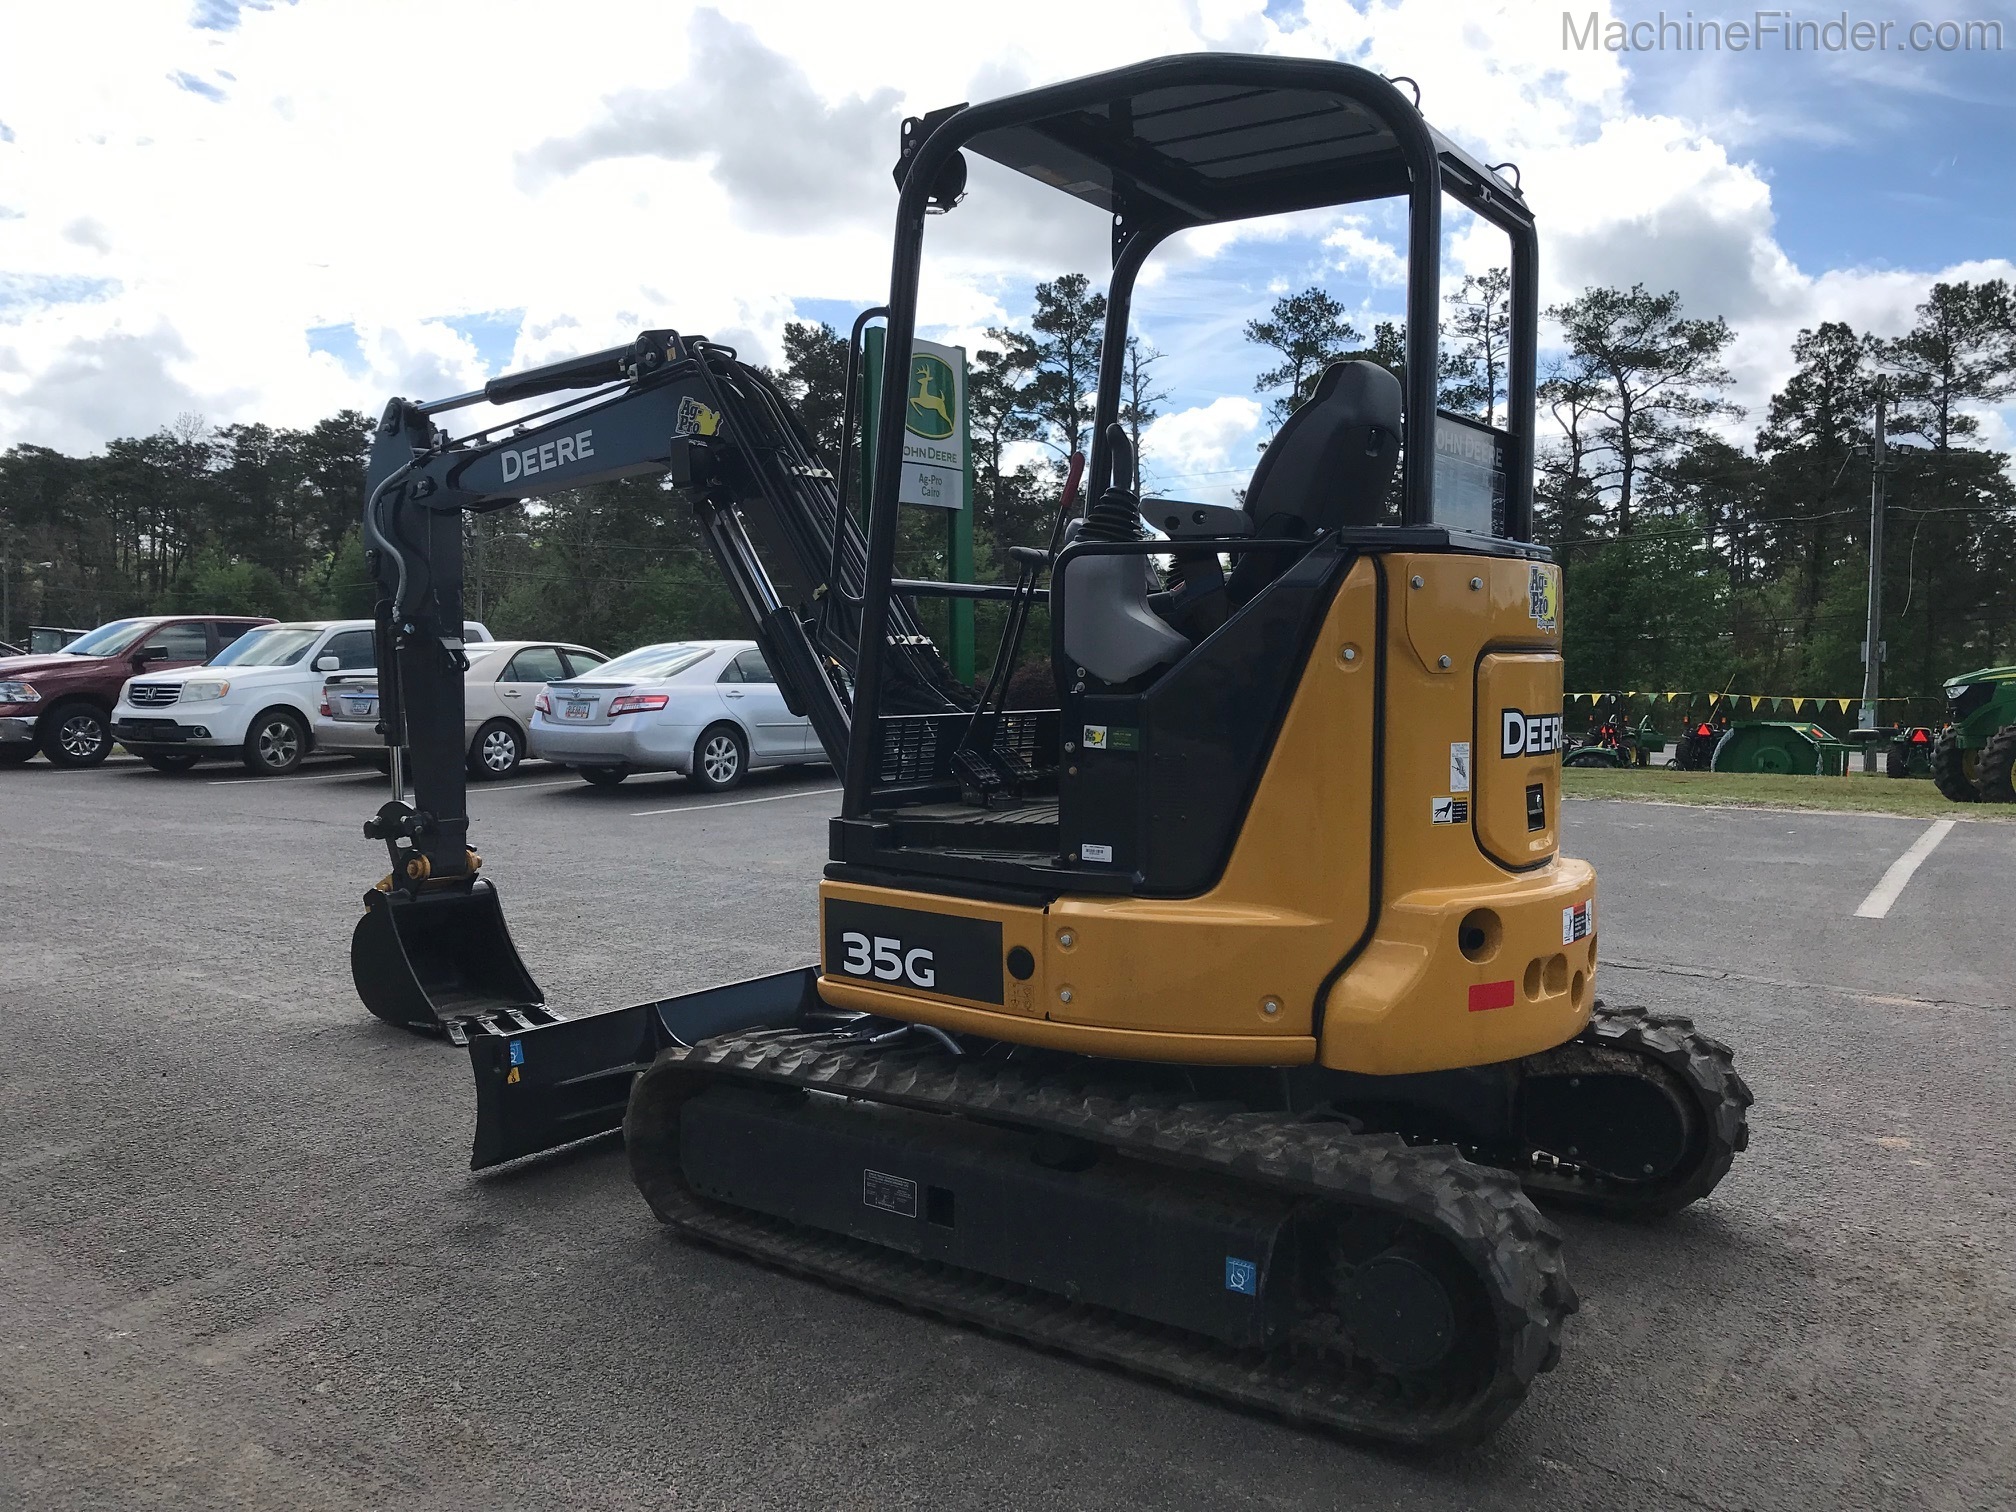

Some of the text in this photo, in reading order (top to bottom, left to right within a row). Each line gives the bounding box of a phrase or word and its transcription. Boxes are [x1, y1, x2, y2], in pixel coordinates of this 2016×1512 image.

[680, 399, 703, 420] Ag-
[678, 415, 701, 434] Pro
[501, 429, 594, 483] DEERE
[903, 445, 957, 464] OHN DEERE
[1435, 427, 1503, 468] OHN DEERE
[918, 473, 943, 486] Ag-Pro
[921, 486, 941, 497] Cairo
[1530, 568, 1548, 597] Ag-
[1530, 591, 1549, 615] Pro
[842, 931, 935, 987] 35G
